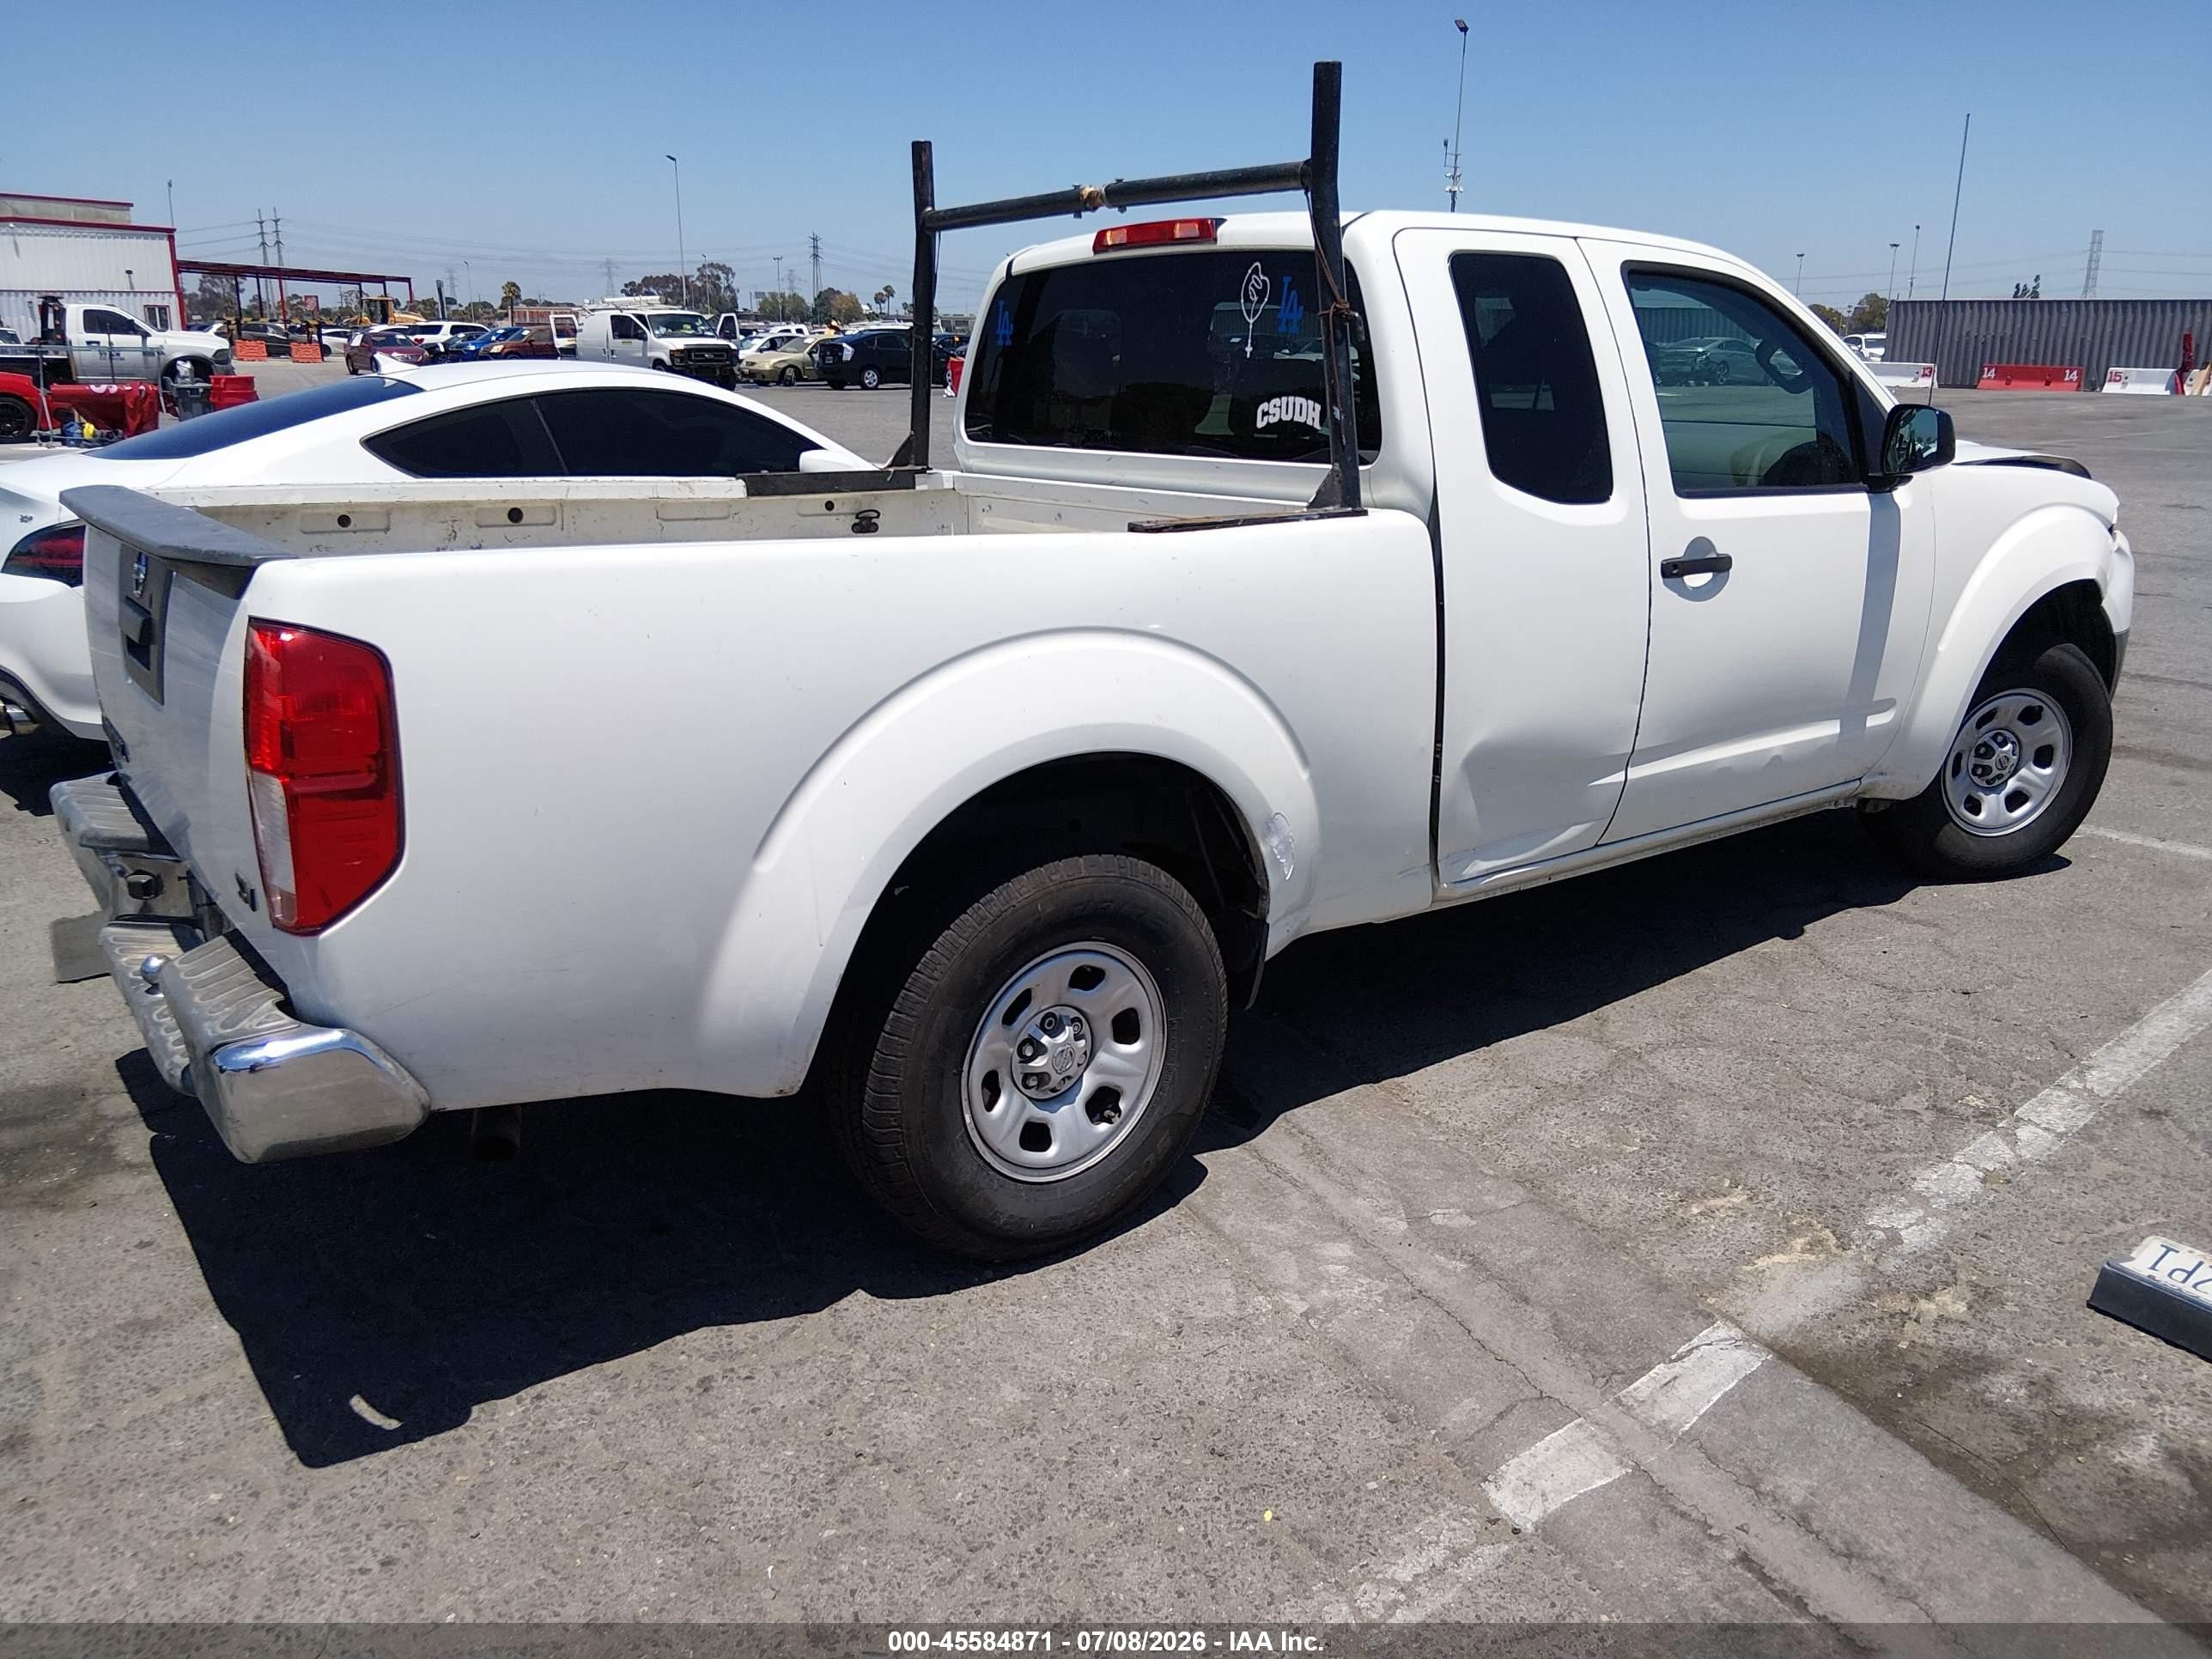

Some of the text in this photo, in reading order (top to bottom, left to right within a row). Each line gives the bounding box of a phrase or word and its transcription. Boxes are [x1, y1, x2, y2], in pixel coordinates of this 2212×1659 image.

[1277, 275, 1304, 335] LA
[995, 300, 1014, 347] LA
[1982, 367, 1996, 379] 14
[2063, 369, 2078, 382] 14
[2107, 371, 2123, 383] 15
[1256, 396, 1322, 430] CSUDH
